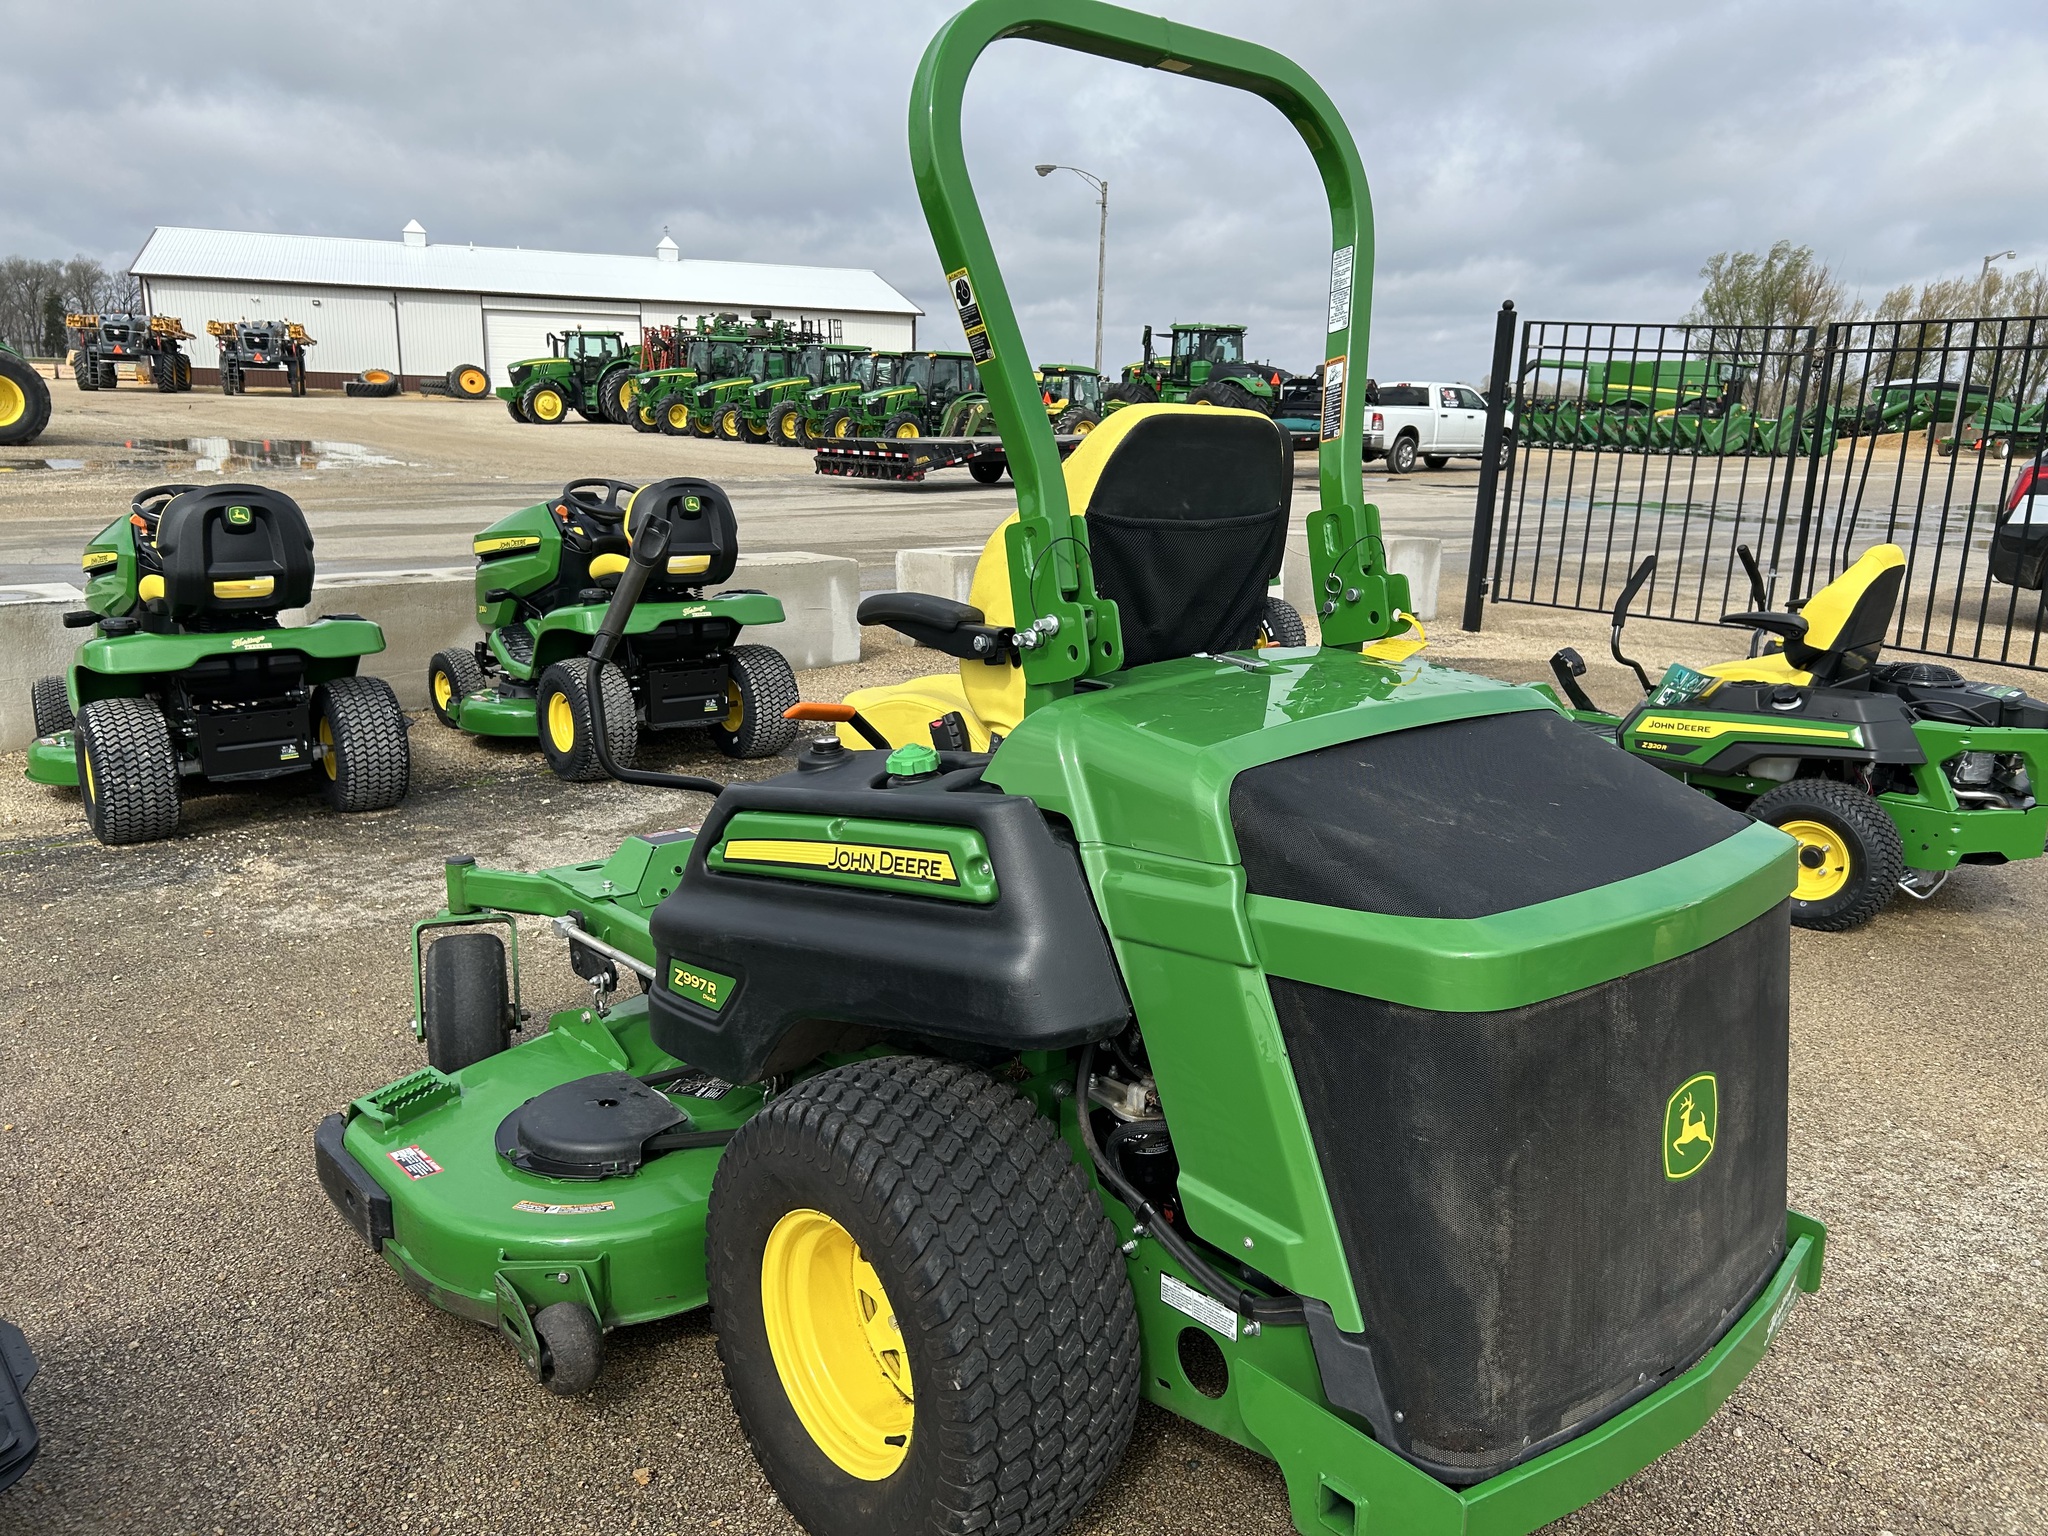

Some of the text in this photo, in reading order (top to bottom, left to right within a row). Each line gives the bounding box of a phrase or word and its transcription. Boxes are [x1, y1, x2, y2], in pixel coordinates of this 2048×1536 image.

[500, 539, 527, 549] JOHN DEERE
[1649, 720, 1711, 733] JOHN DEERE
[1641, 741, 1668, 751] Z320R
[828, 846, 942, 878] JOHN DEERE
[674, 967, 717, 996] Z997R
[702, 993, 717, 1003] Diesel
